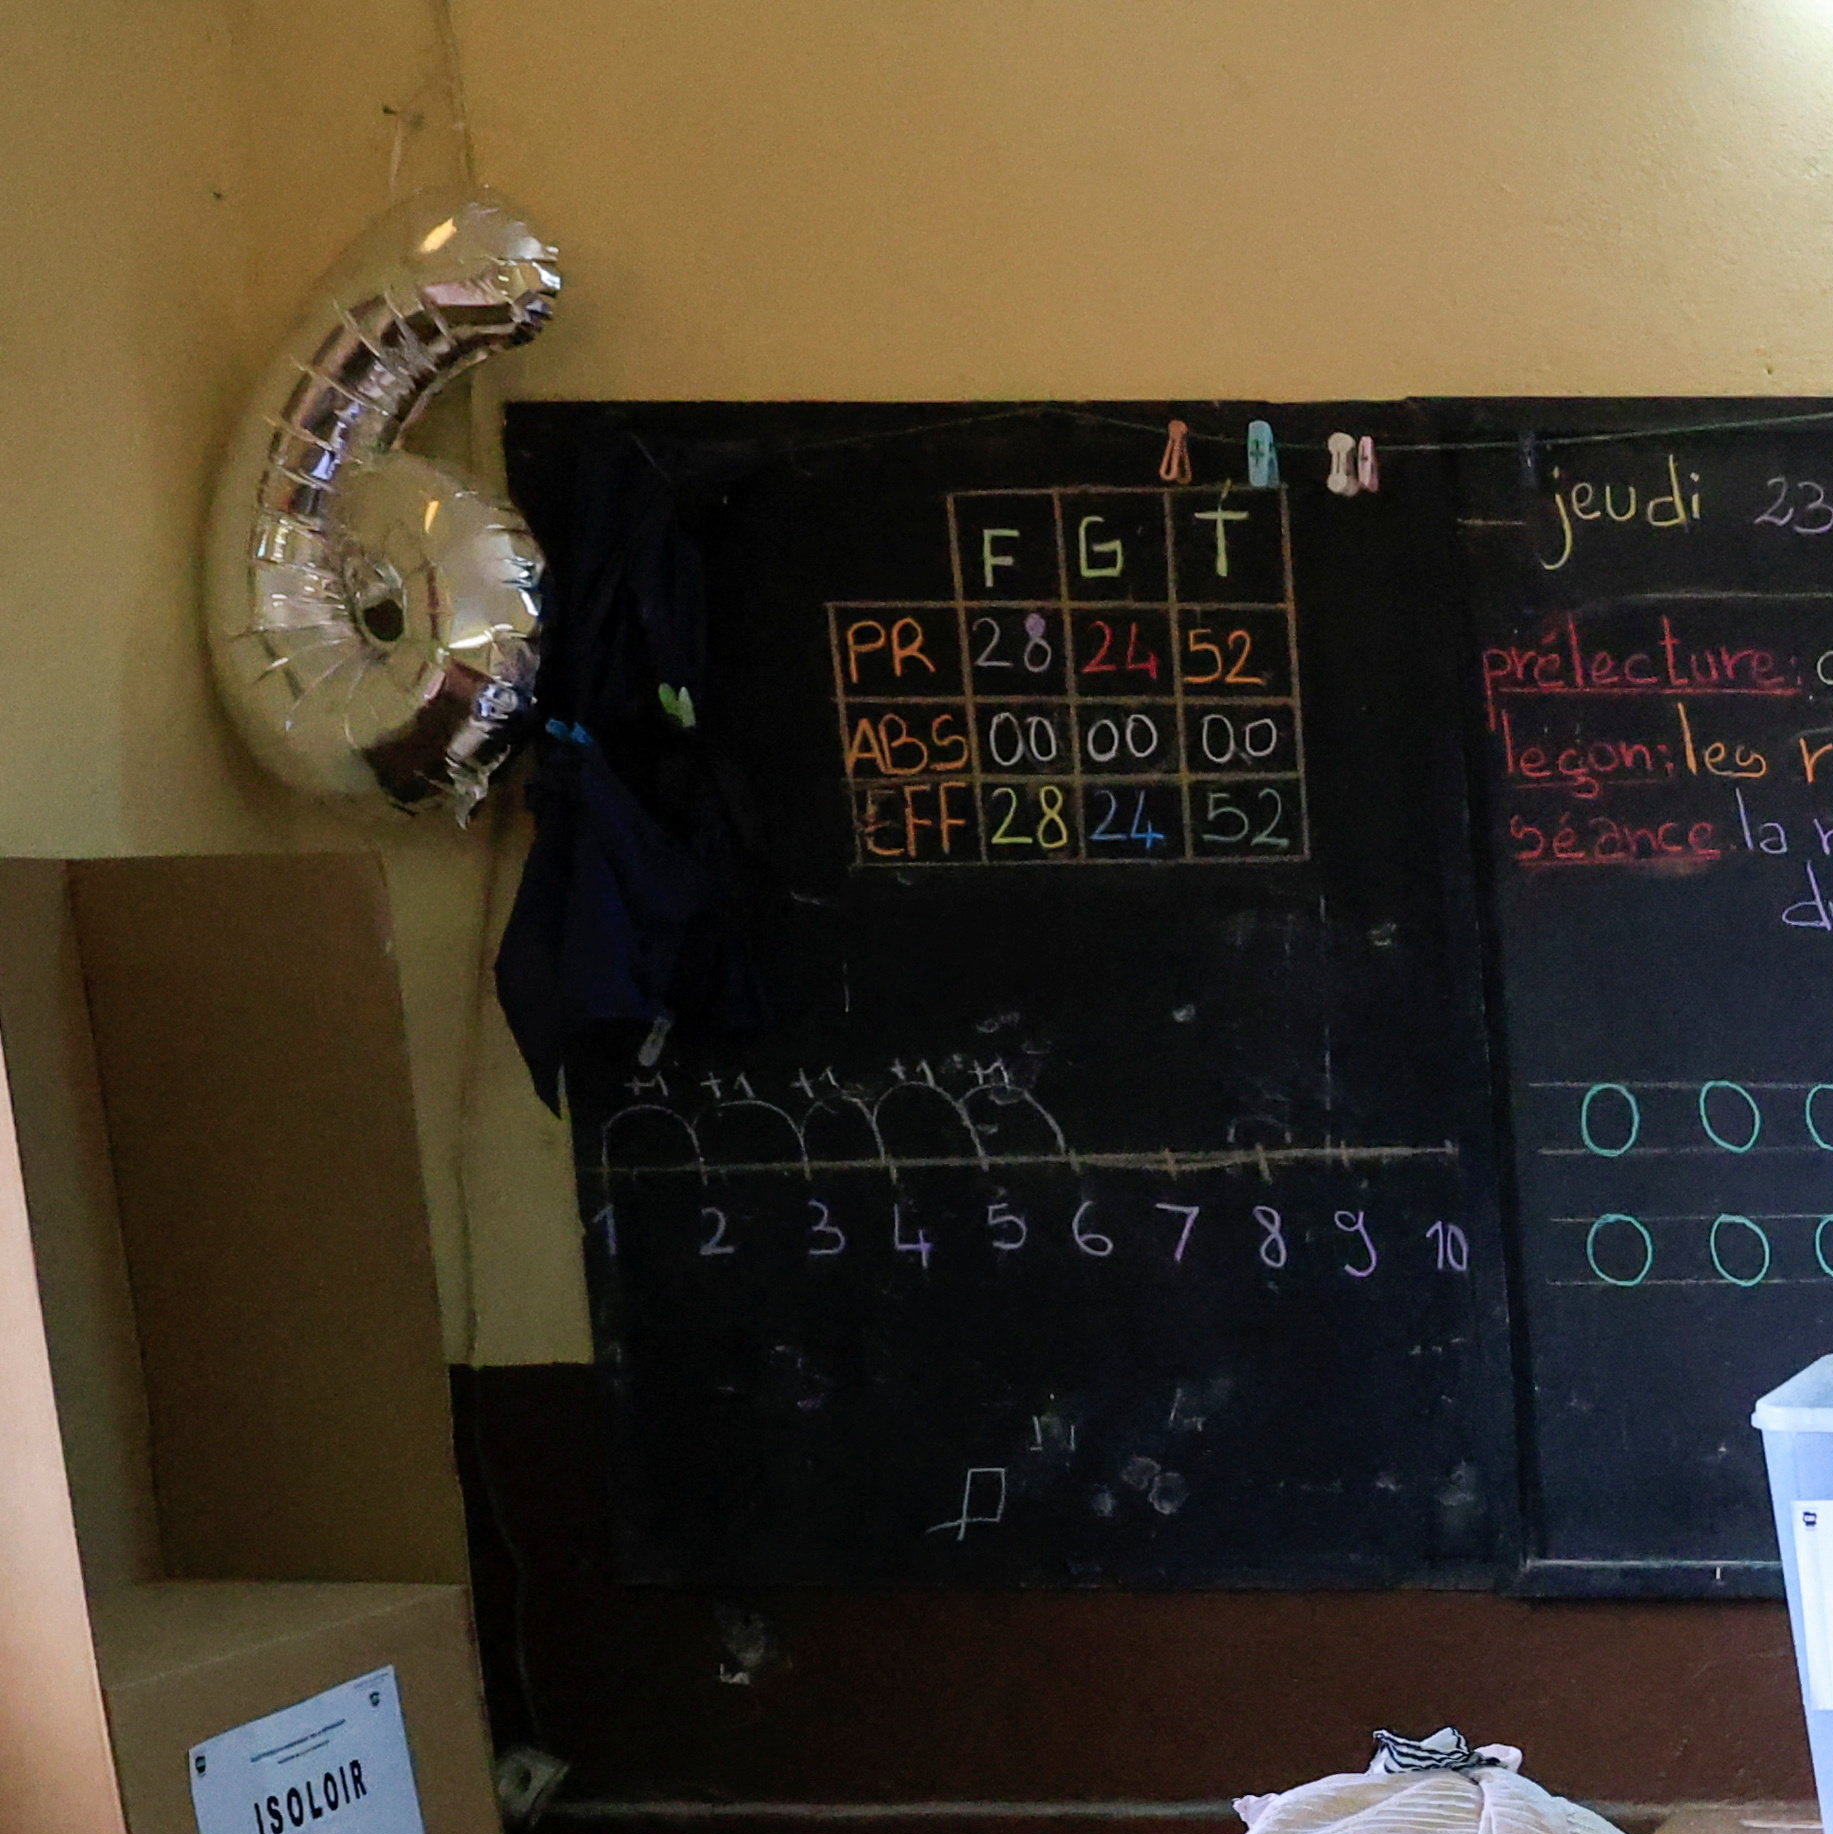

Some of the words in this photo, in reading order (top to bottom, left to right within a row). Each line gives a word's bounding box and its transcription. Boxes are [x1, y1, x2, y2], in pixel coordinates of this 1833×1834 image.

[983, 527, 1019, 588] F
[1079, 515, 1124, 579] G
[1193, 500, 1250, 578] T
[1541, 454, 1702, 570] jeudi
[845, 620, 935, 684] PR
[972, 612, 1053, 676] 28
[1083, 620, 1159, 680] 24
[1183, 627, 1268, 687] 52
[844, 713, 969, 776] ABS
[1677, 701, 1767, 778] les
[858, 783, 969, 858] EFF
[990, 787, 1069, 851] 28
[1089, 789, 1165, 850] 24
[1202, 791, 1290, 850] 52
[1735, 789, 1790, 856] la
[699, 1207, 735, 1256] 2
[809, 1200, 847, 1256] 3
[895, 1203, 933, 1268] 4
[985, 1202, 1027, 1250] 5
[1072, 1203, 1114, 1258] 6
[1155, 1203, 1200, 1263] 7
[1252, 1207, 1288, 1268] 8
[1334, 1209, 1378, 1278] 9
[1426, 1219, 1470, 1272] 10
